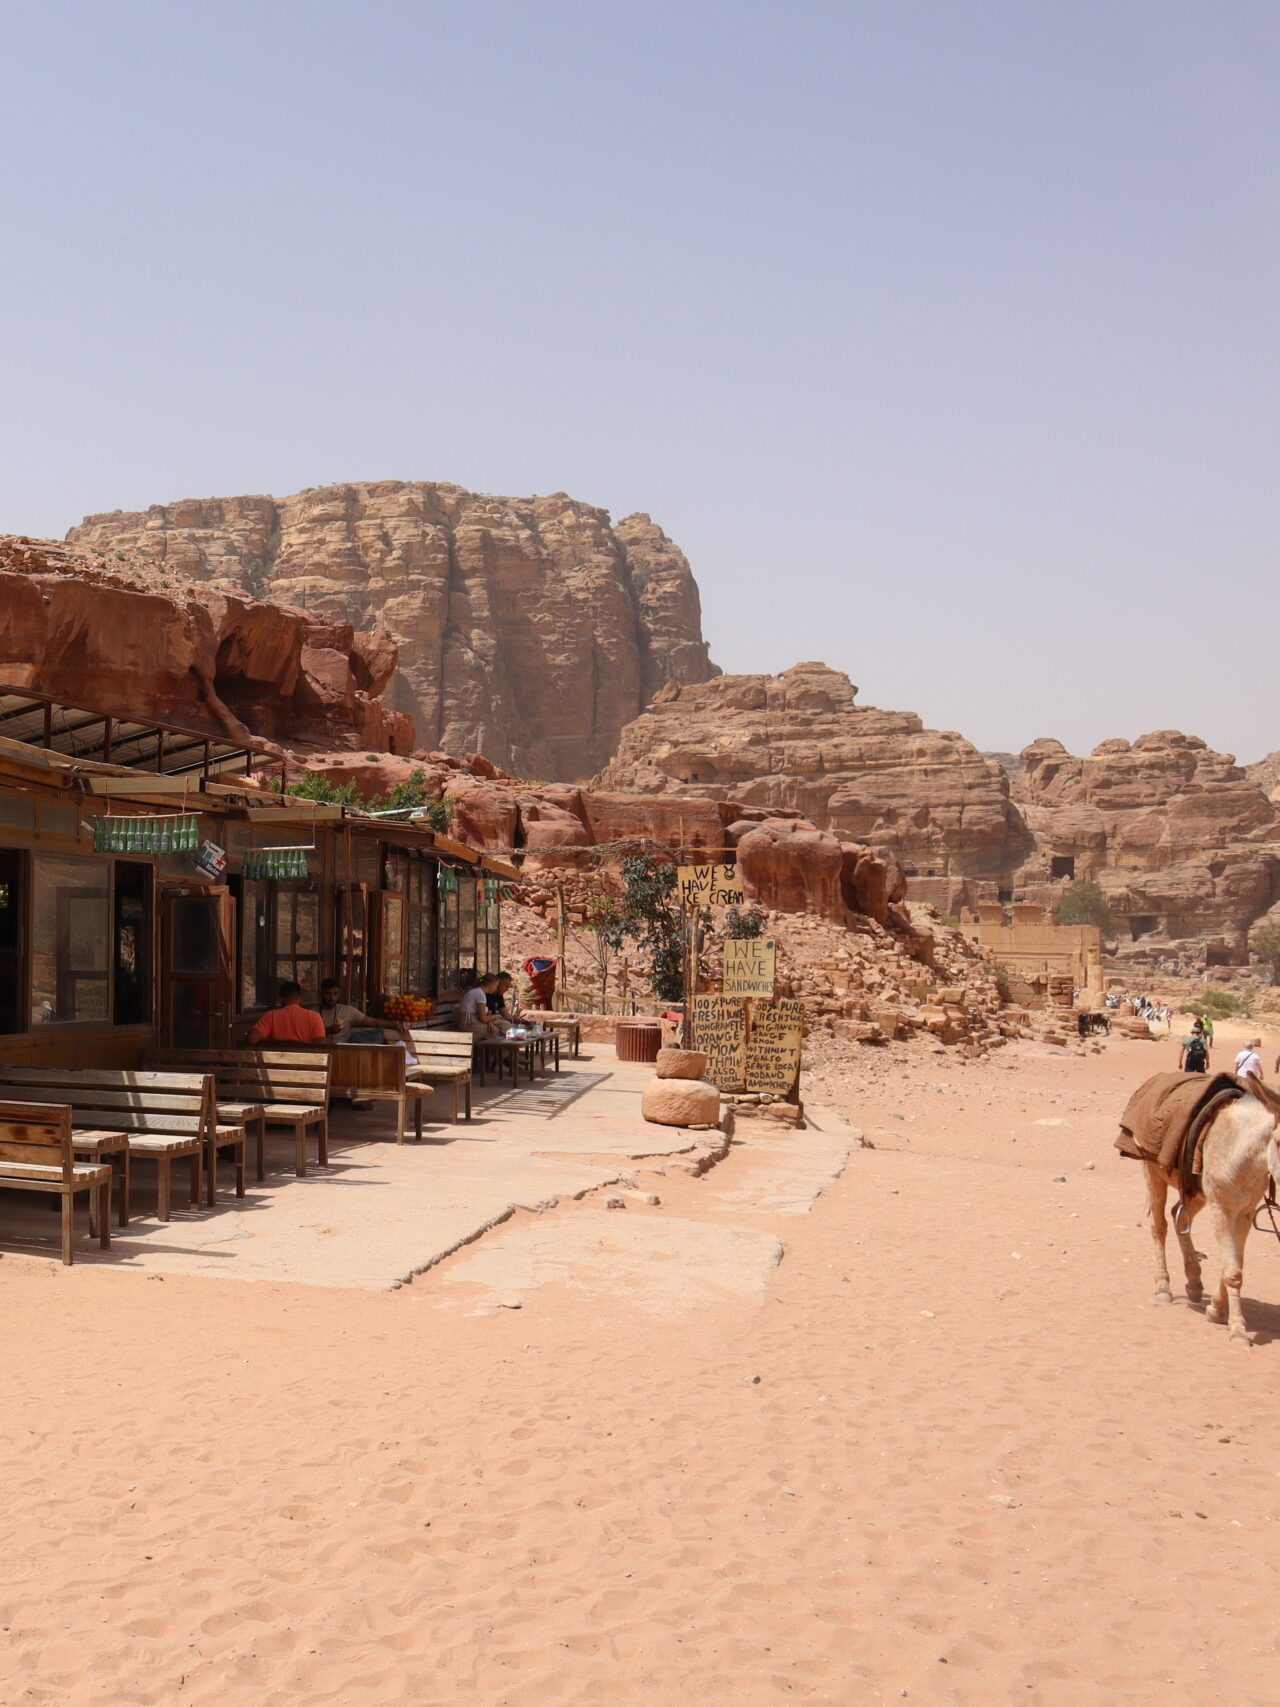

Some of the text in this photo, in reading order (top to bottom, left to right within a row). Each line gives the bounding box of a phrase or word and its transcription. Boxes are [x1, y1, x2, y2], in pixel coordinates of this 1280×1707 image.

[694, 866, 718, 880] WE
[682, 879, 718, 895] HAVE
[709, 890, 744, 905] CREAM
[733, 941, 762, 959] WE
[726, 960, 766, 976] HAVE
[725, 978, 774, 993] SANDWICHES
[720, 996, 743, 1008] PURE
[692, 1009, 724, 1023] FRESH
[757, 1012, 784, 1023] RESH
[696, 1031, 740, 1045] ORANGE
[753, 1031, 786, 1041] RANGE
[753, 1037, 775, 1045] EMON
